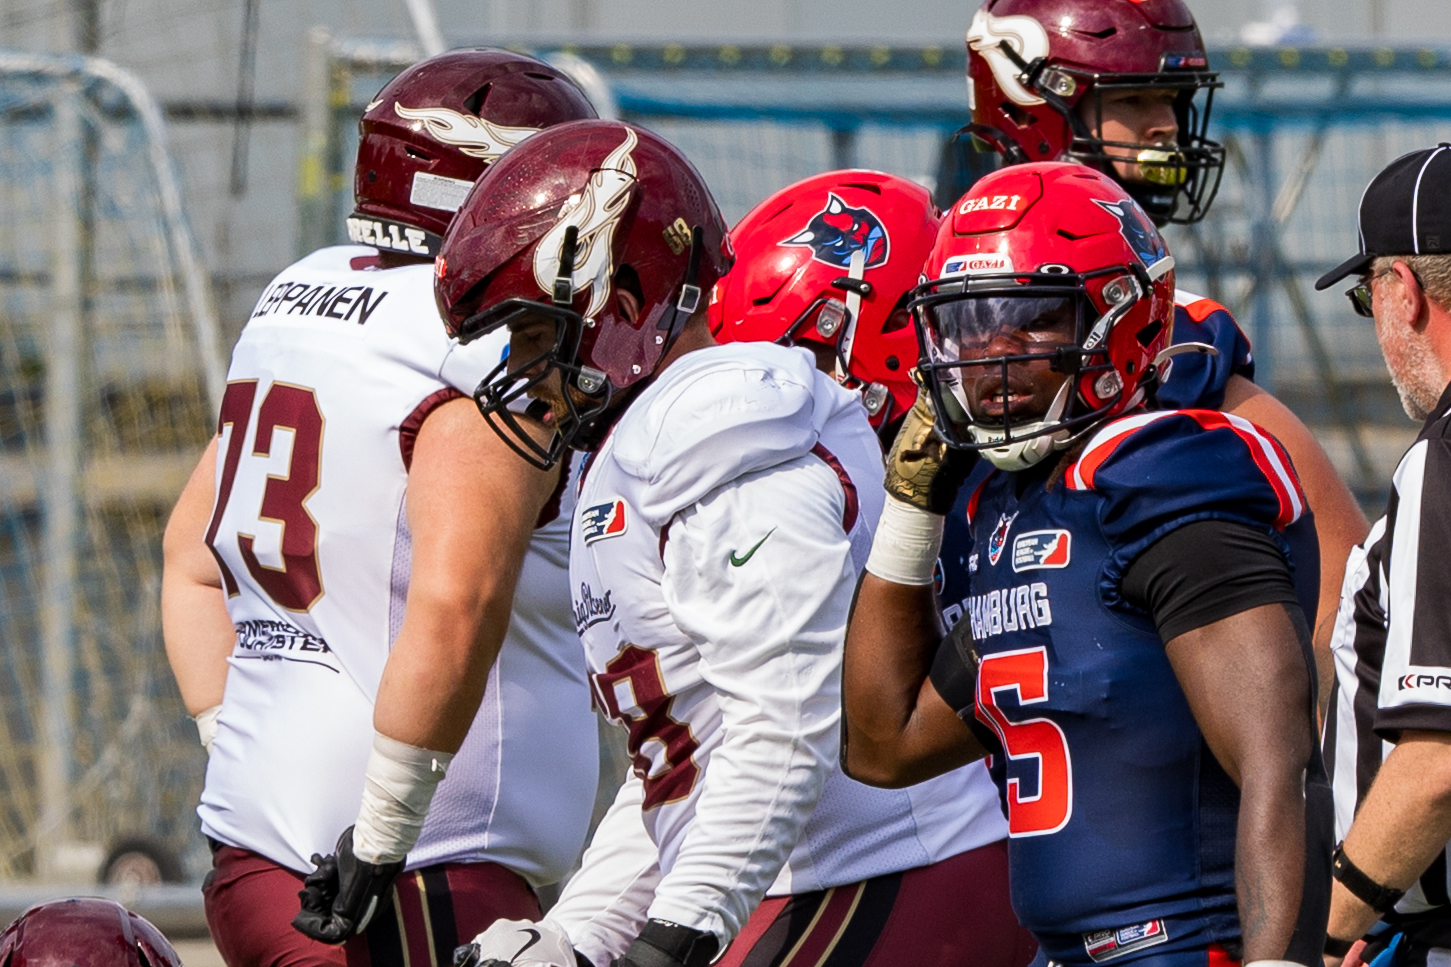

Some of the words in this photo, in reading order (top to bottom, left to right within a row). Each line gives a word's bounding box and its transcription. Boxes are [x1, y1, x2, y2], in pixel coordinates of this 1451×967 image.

[203, 378, 326, 613] 73
[970, 582, 1052, 640] HAMBURG
[1398, 674, 1451, 691] KPR
